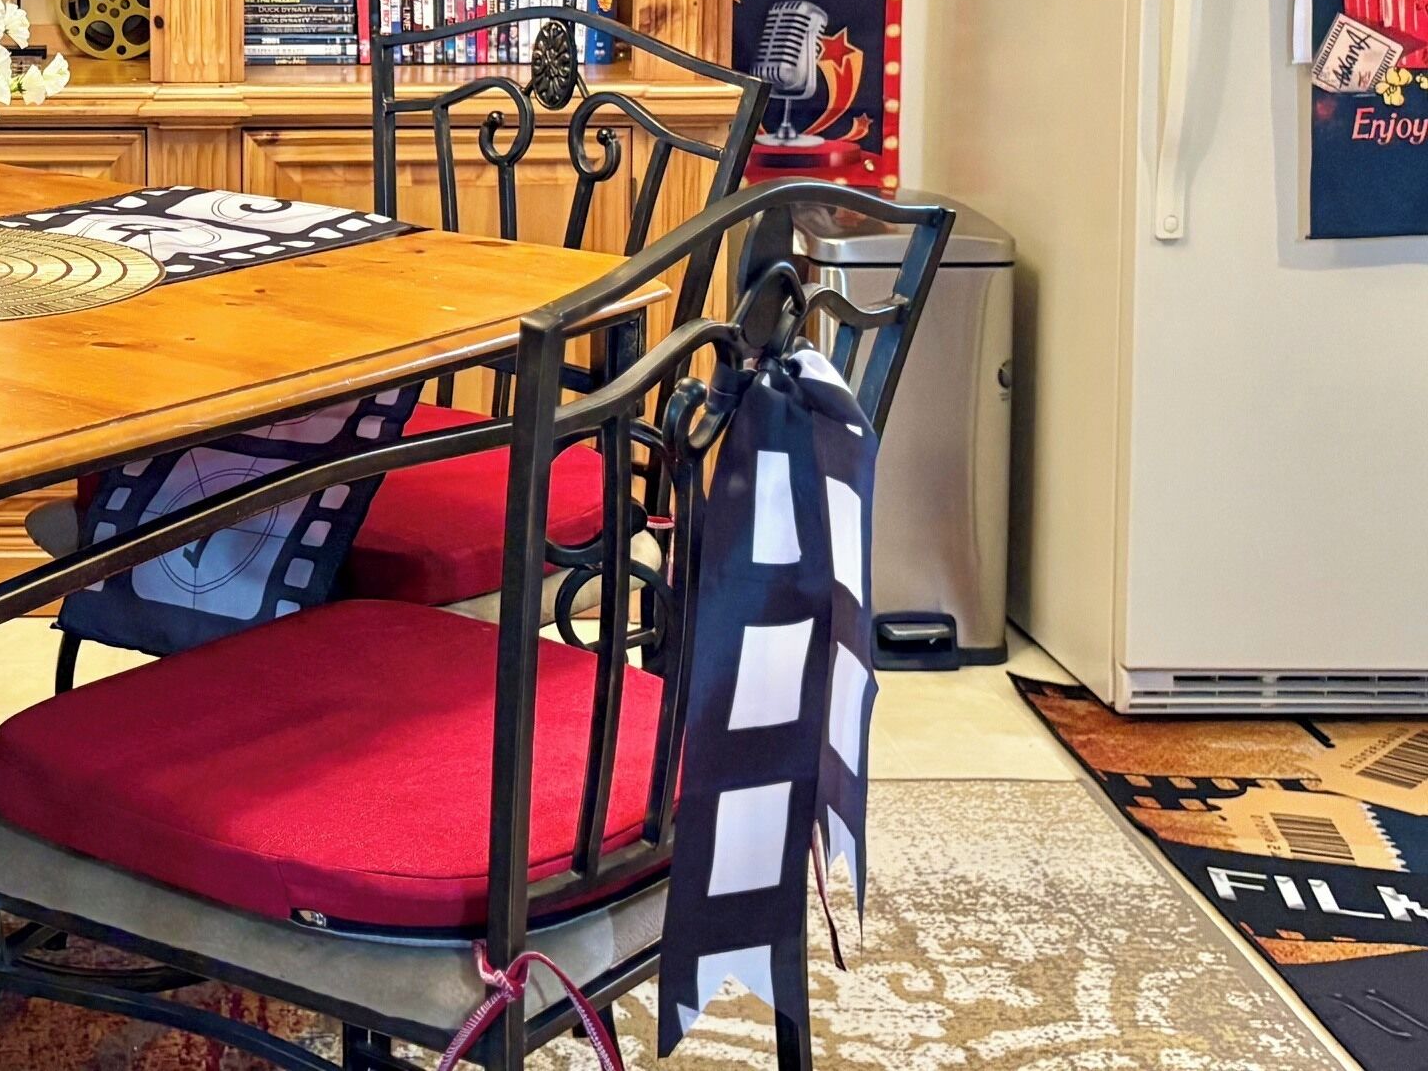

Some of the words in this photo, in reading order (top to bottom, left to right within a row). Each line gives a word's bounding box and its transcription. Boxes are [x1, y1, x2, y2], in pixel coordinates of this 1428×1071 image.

[281, 5, 317, 13] DYNASTY
[402, 6, 411, 31] LINE
[1352, 106, 1428, 146] Enjoy
